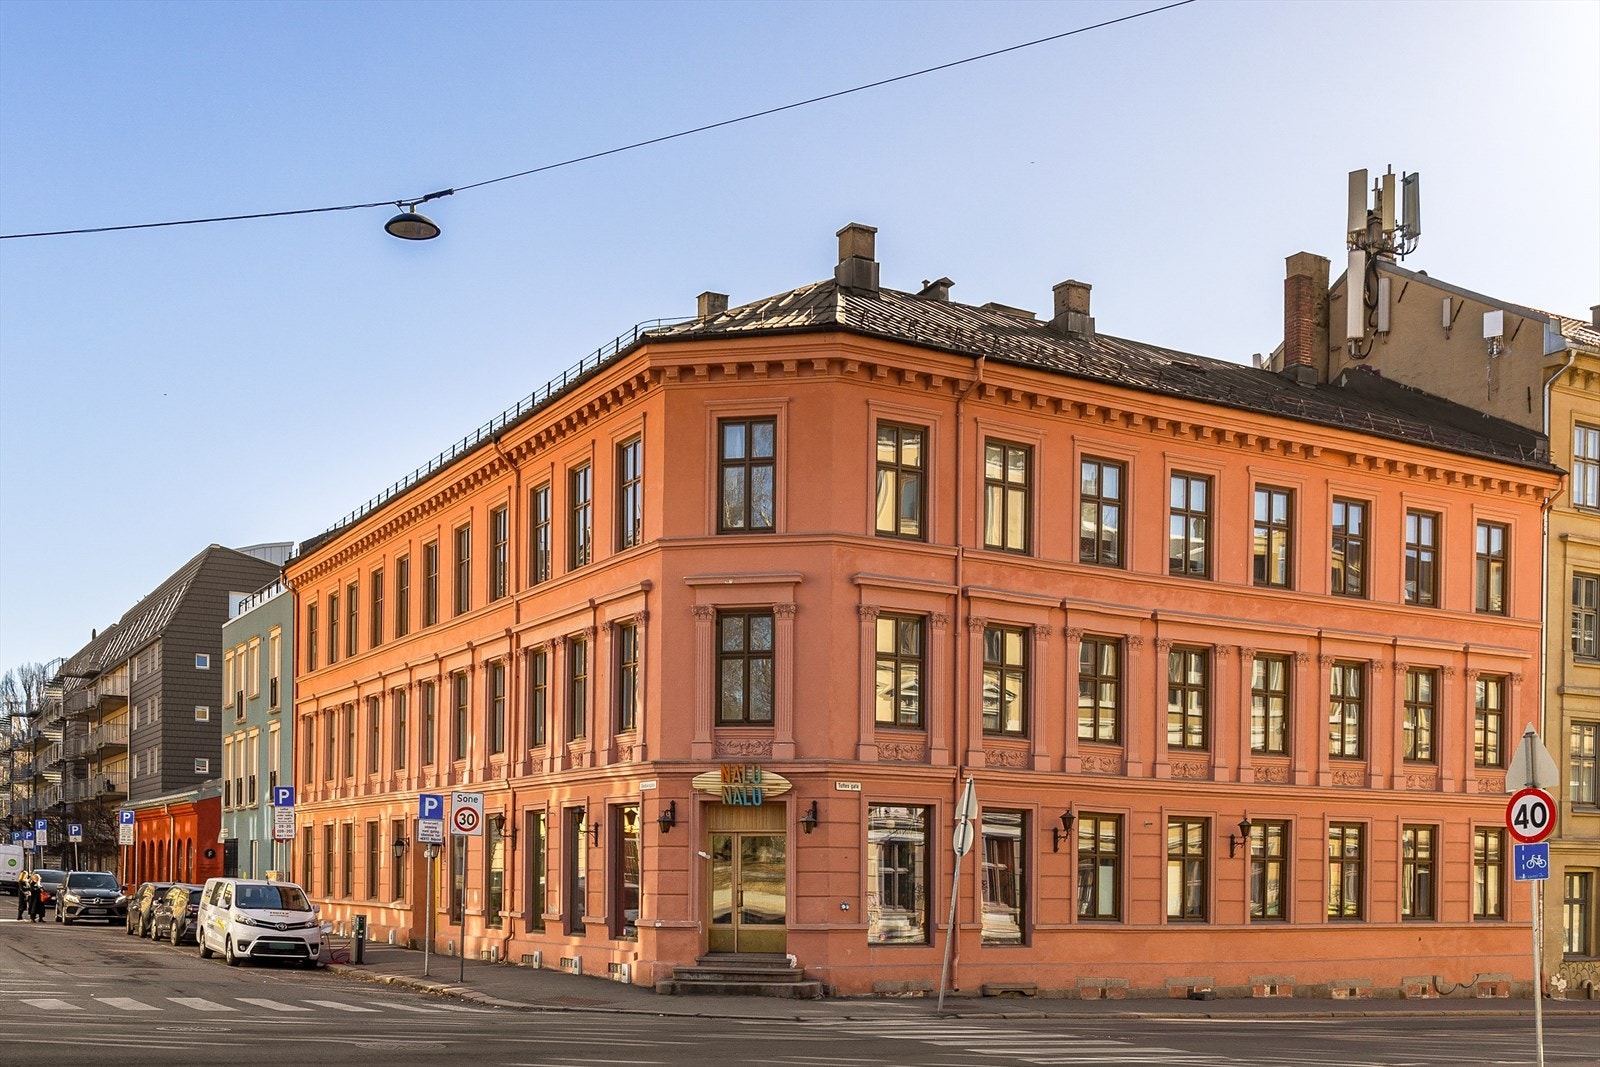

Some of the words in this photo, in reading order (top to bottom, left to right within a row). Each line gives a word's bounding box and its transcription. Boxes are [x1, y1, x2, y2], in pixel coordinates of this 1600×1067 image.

[720, 763, 762, 784] NALU
[279, 789, 290, 805] P
[456, 794, 479, 803] Sone
[721, 785, 763, 806] NALU
[425, 797, 438, 817] P
[123, 812, 131, 823] P
[459, 813, 475, 826] 30
[1514, 802, 1547, 829] 40
[37, 821, 44, 829] P
[71, 825, 79, 835] P
